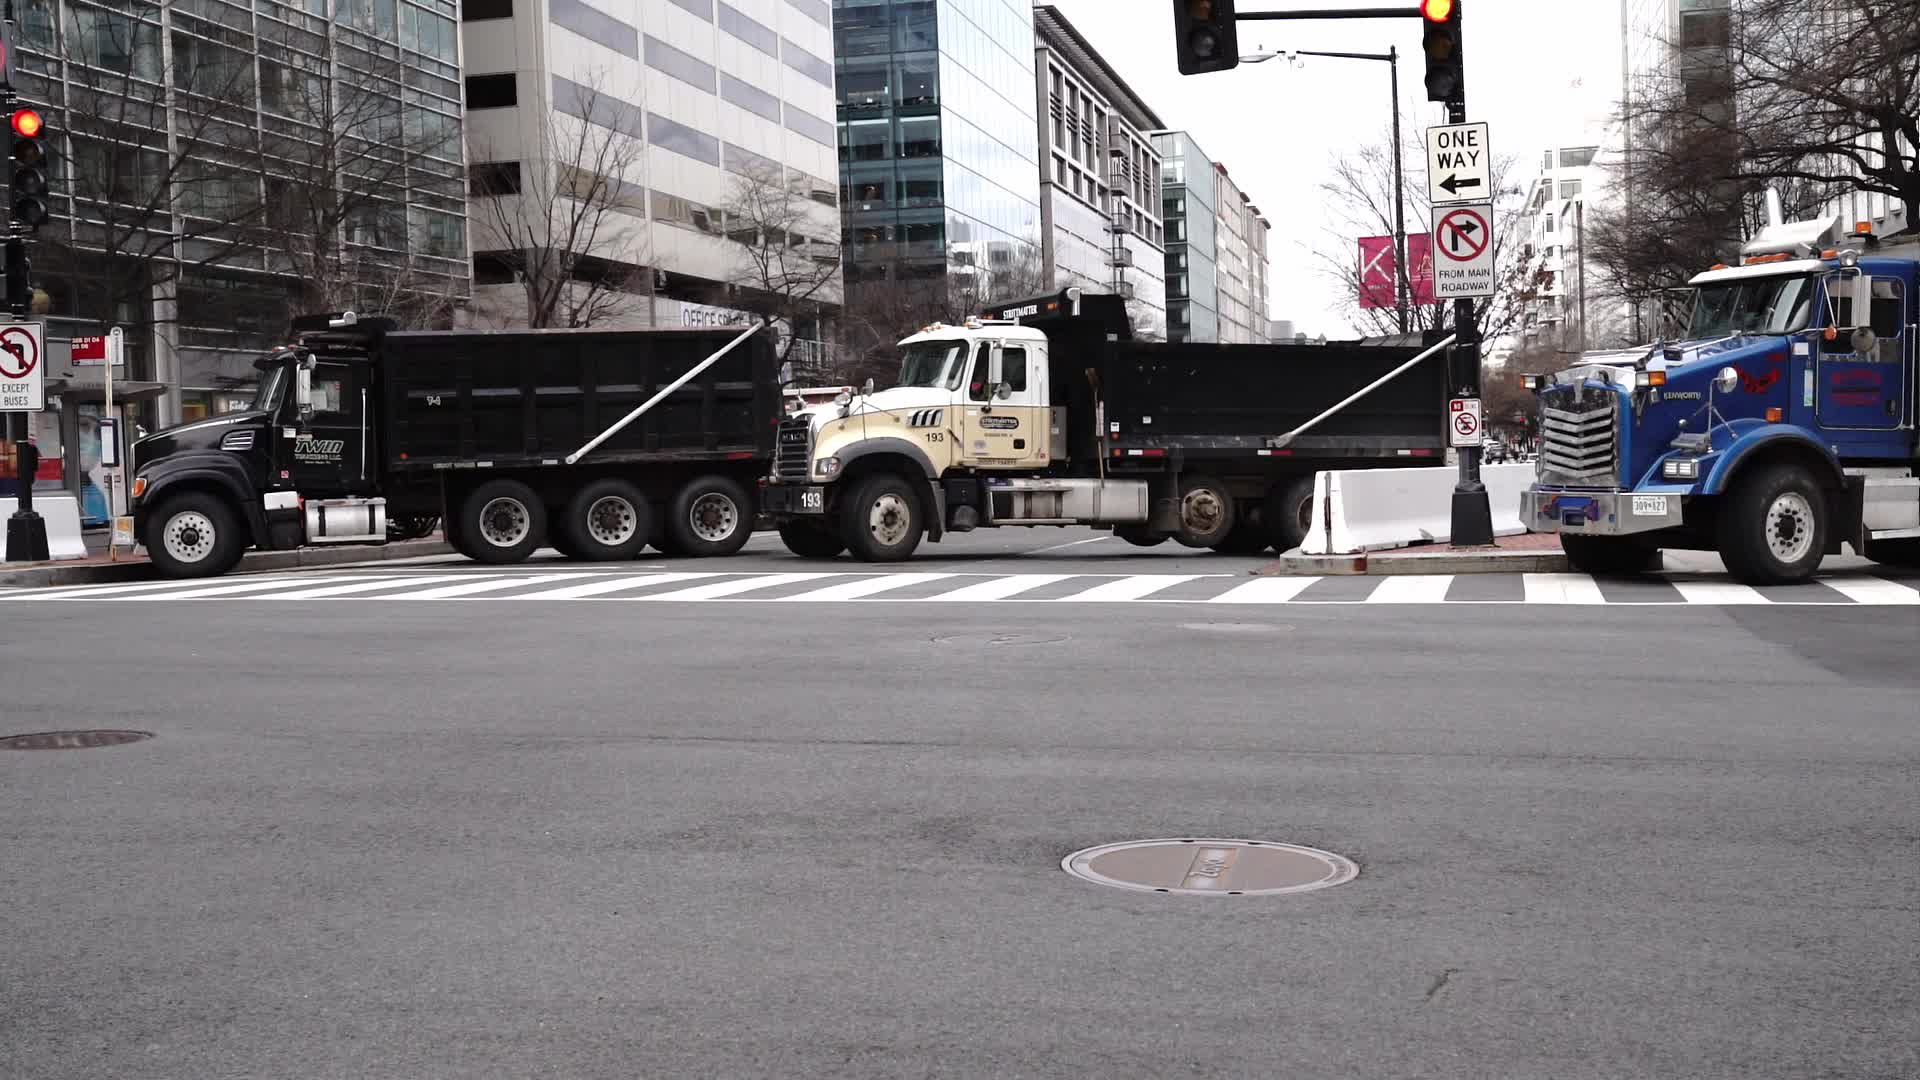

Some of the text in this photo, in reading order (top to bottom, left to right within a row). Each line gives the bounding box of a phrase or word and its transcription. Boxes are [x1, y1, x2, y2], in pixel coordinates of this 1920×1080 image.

[1438, 130, 1478, 149] ONE
[1437, 149, 1480, 169] WAY
[1360, 245, 1392, 283] K
[1439, 267, 1490, 279] FROM MAIN
[1441, 281, 1489, 292] ROADWAY
[683, 308, 716, 328] OFFICE
[2, 383, 29, 393] EXCEPT
[4, 396, 29, 406] BUSES
[925, 432, 944, 443] 193
[801, 492, 821, 508] 193
